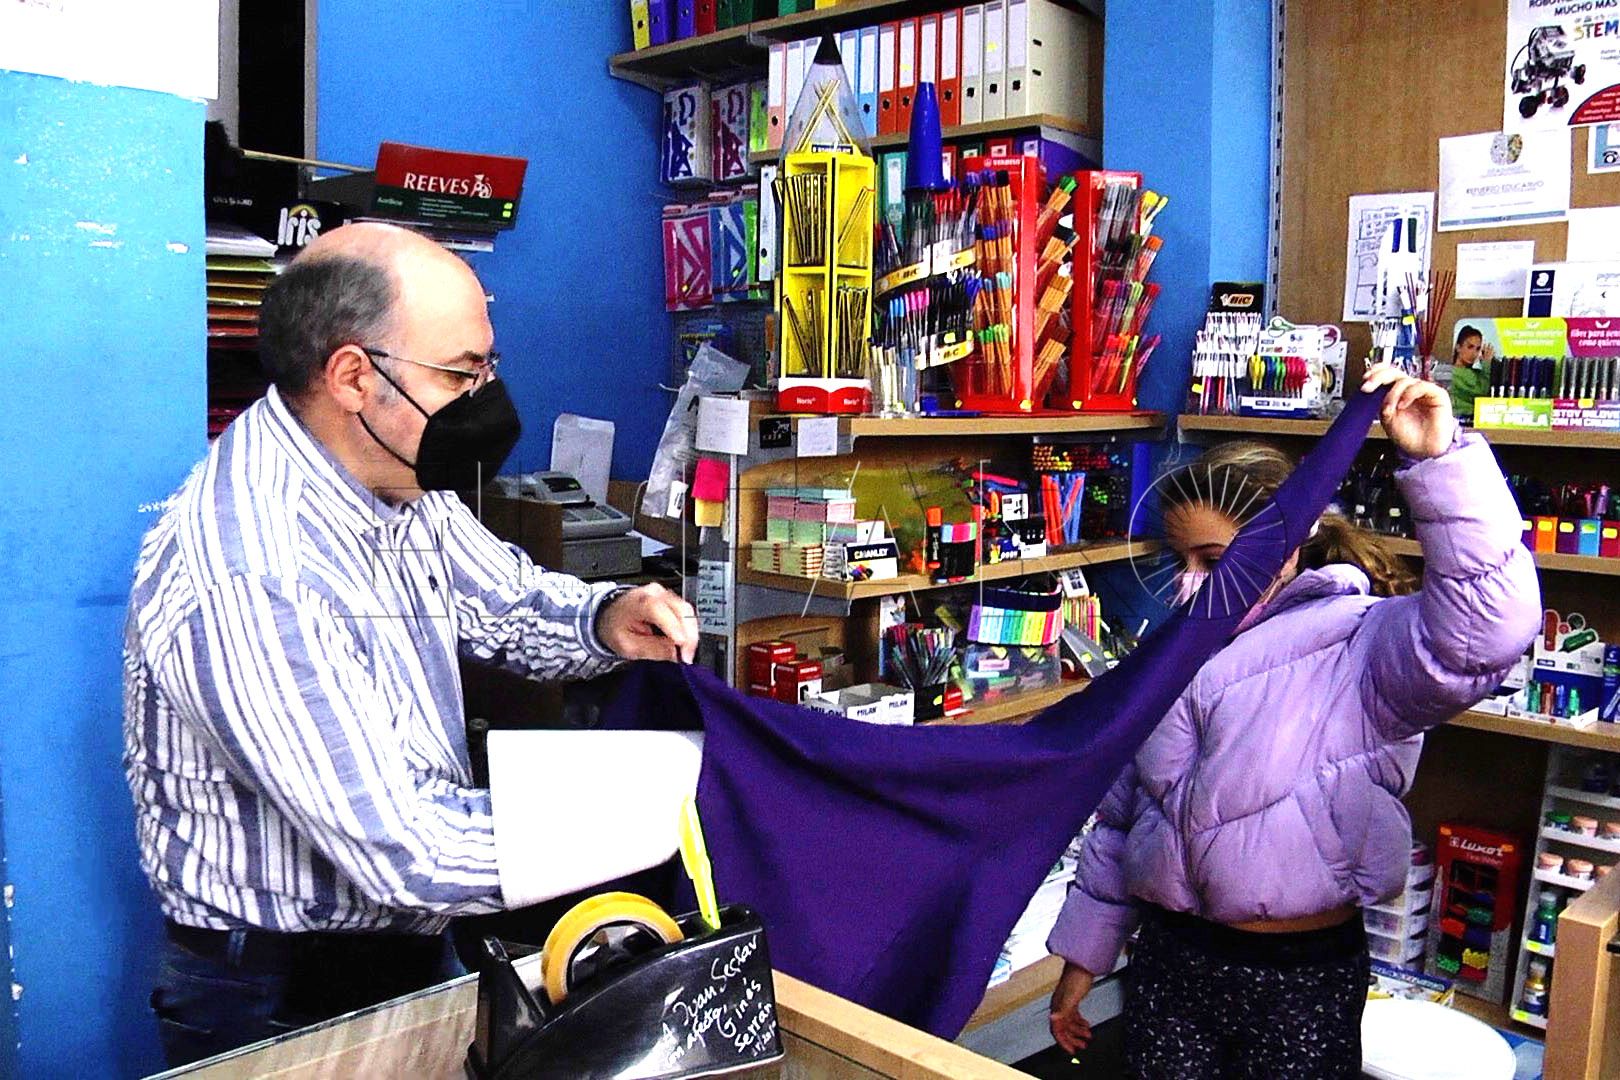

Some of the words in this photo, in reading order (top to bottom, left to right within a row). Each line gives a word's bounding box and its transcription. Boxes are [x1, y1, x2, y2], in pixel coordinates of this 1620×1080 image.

[1555, 2, 1592, 16] MUCHO
[1574, 20, 1619, 41] STEM
[403, 172, 471, 196] REEVES
[857, 706, 877, 717] MILAN
[889, 700, 908, 710] MILAN
